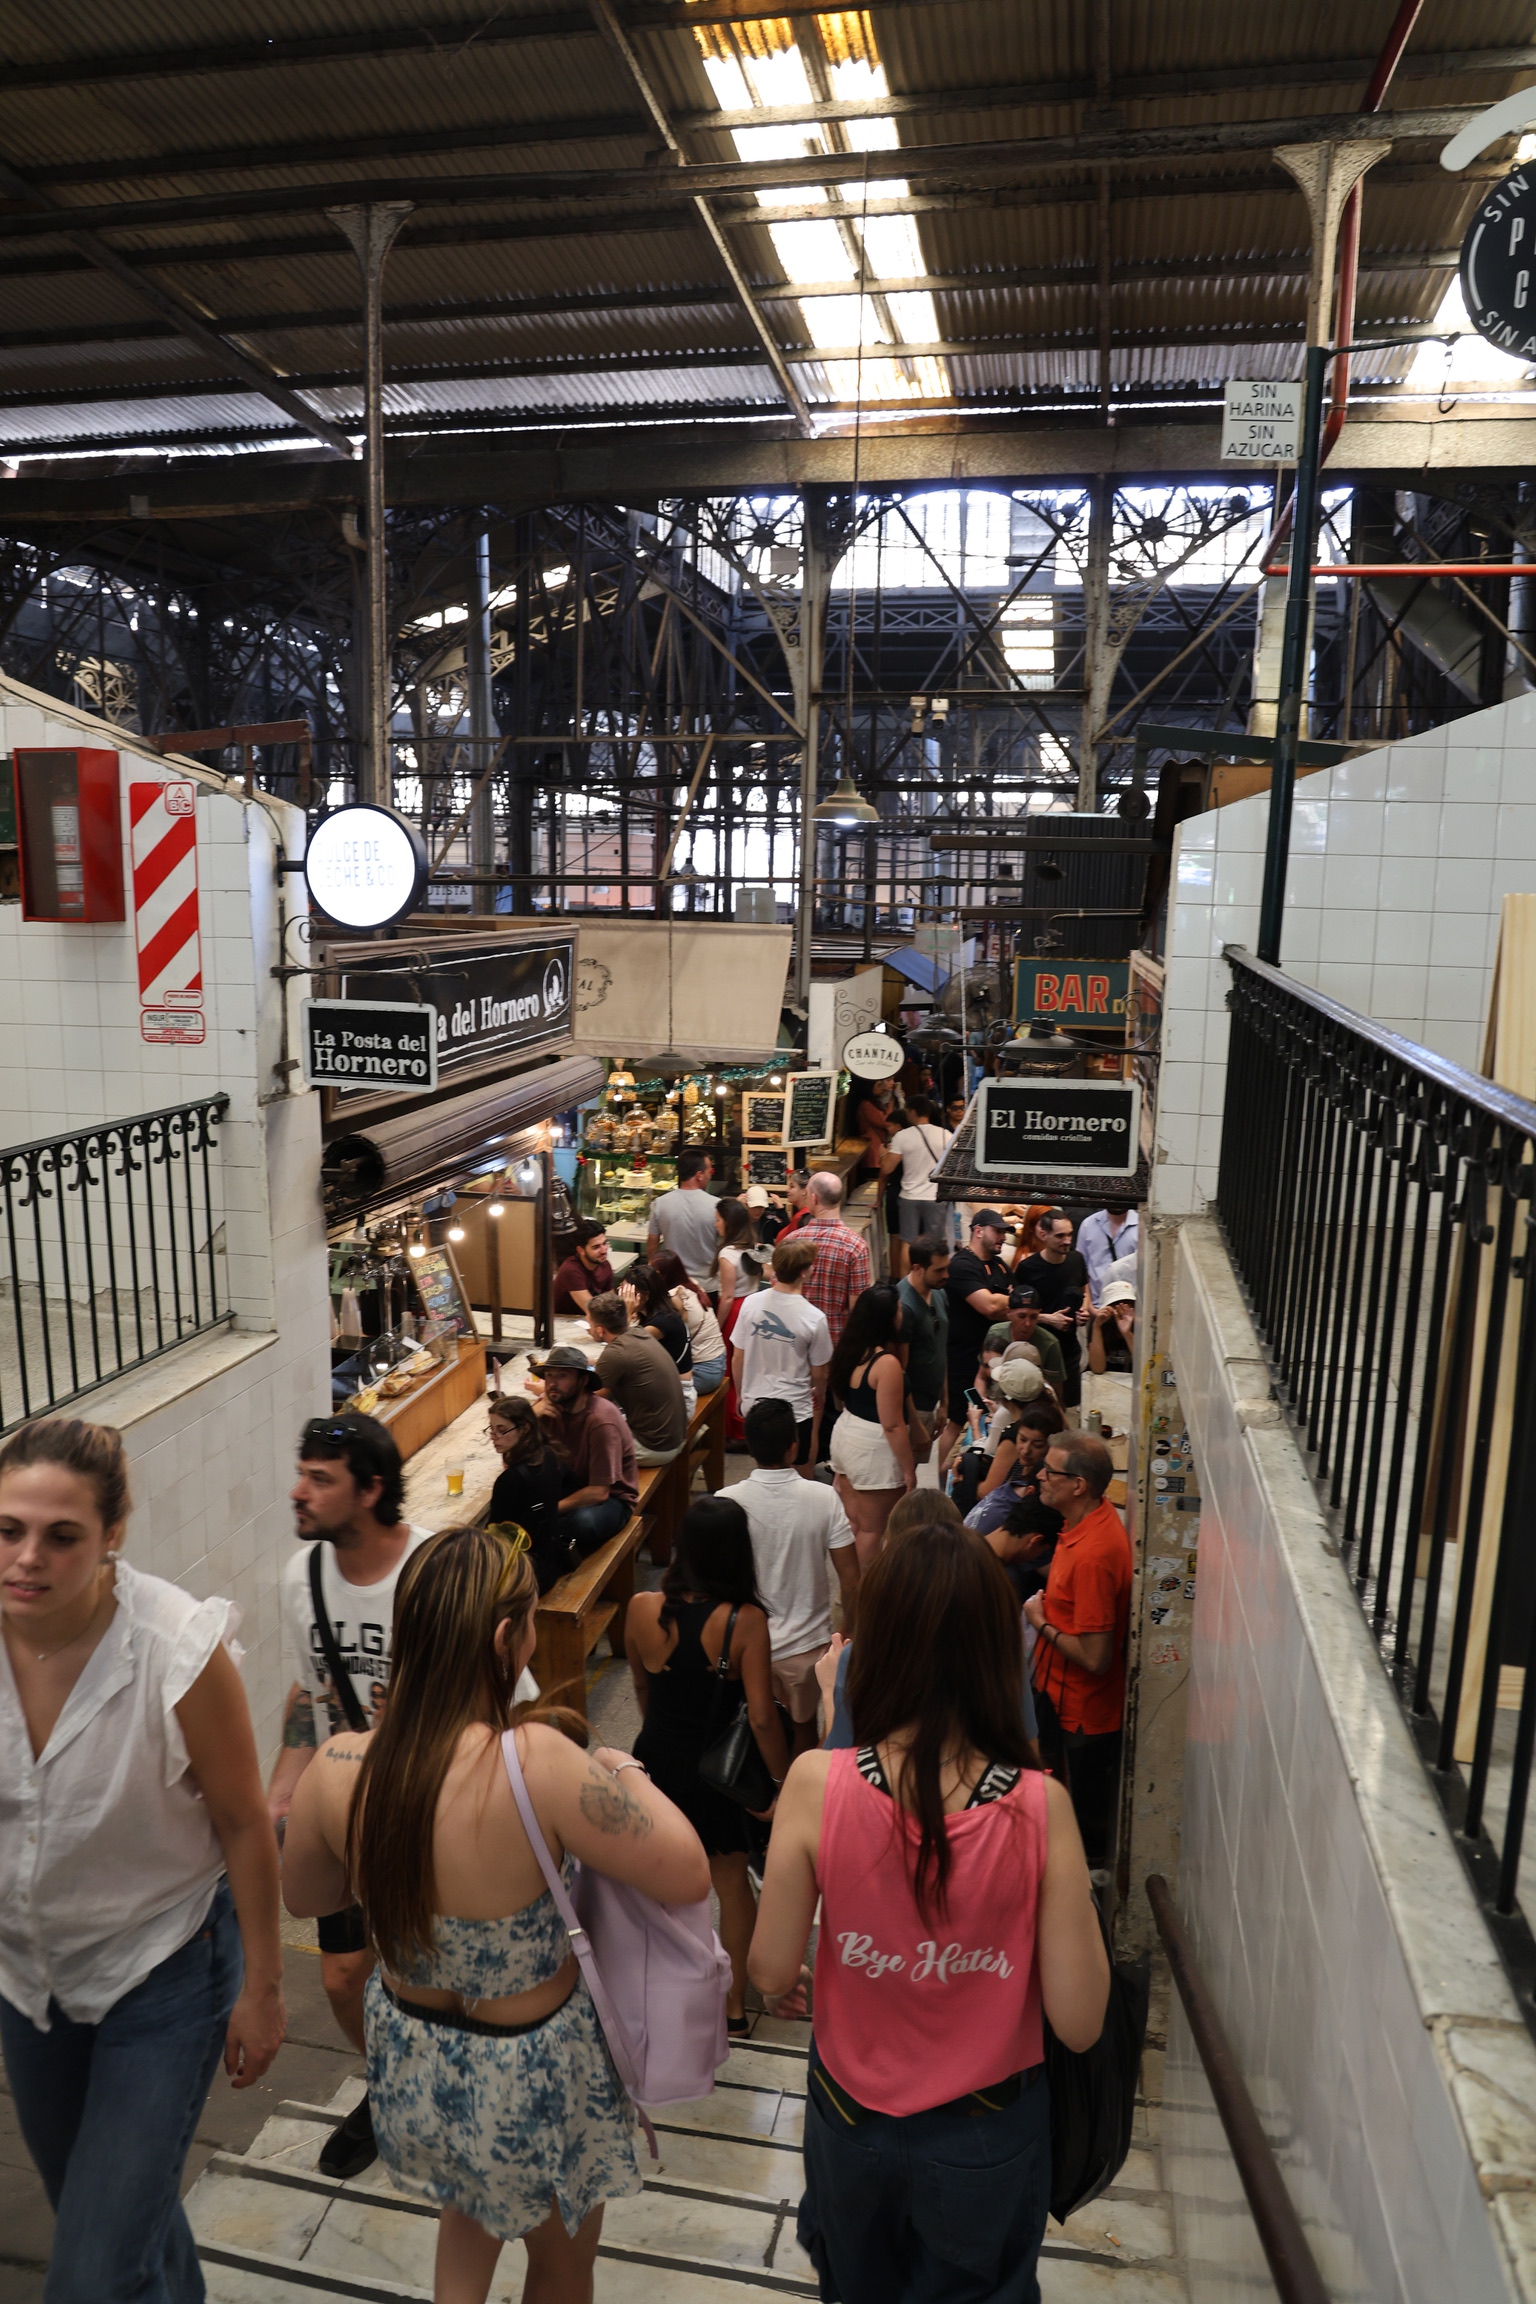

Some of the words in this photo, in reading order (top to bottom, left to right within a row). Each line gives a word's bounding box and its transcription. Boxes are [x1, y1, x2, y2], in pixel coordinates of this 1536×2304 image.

[1484, 174, 1531, 223] SIN
[1478, 310, 1520, 348] SIN
[1251, 383, 1278, 398] SIN
[1229, 401, 1296, 417] HARINA
[1248, 424, 1275, 440] SIN
[1226, 442, 1295, 458] AZUCAR
[363, 839, 381, 862] DE
[576, 977, 593, 991] AL
[1034, 973, 1110, 1014] BAR
[451, 999, 477, 1037] del
[480, 993, 540, 1031] Hornero
[313, 1029, 336, 1046] La
[341, 1031, 393, 1049] Posta
[397, 1034, 428, 1052] del
[314, 1047, 428, 1077] Hornero
[848, 1048, 900, 1063] CHANTAL
[990, 1109, 1016, 1129] El
[1024, 1110, 1128, 1132] Hornero
[1022, 1133, 1059, 1141] comidas
[1059, 1134, 1093, 1142] criollas
[837, 1931, 907, 1979] Bye
[910, 1940, 1014, 1985] Hater
